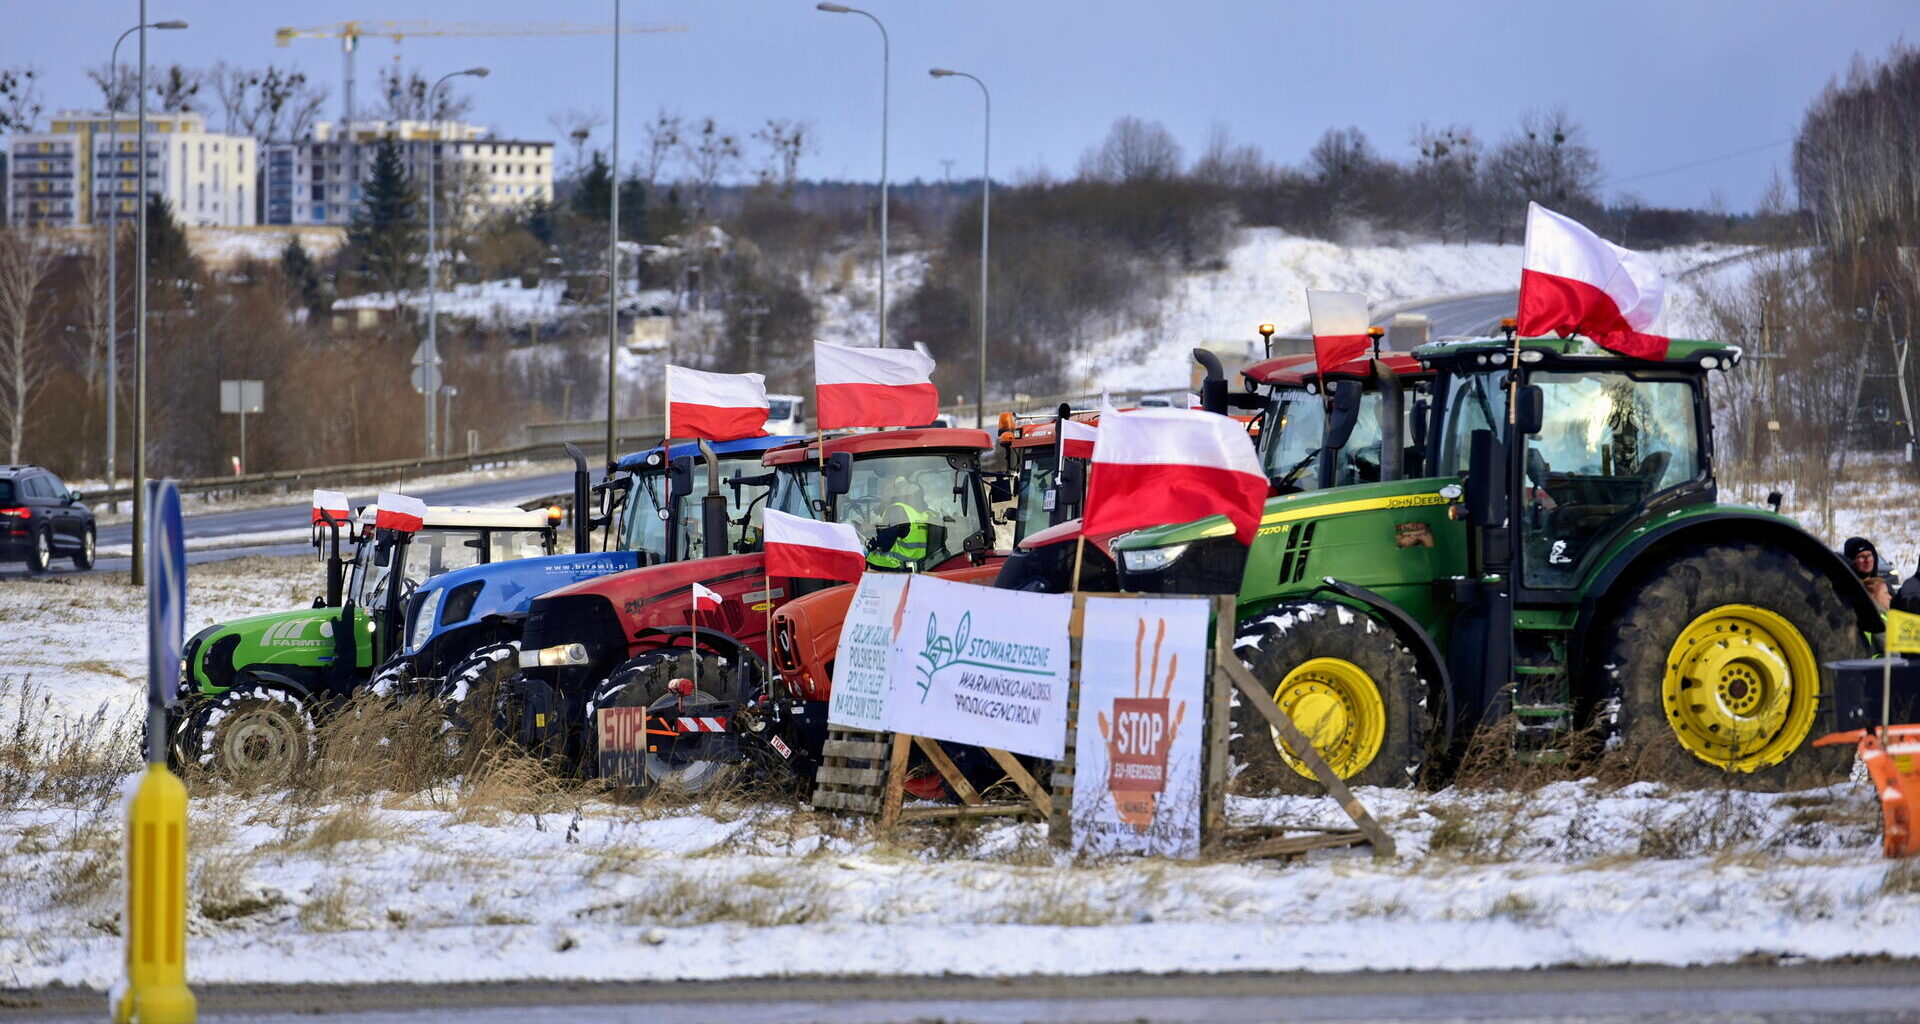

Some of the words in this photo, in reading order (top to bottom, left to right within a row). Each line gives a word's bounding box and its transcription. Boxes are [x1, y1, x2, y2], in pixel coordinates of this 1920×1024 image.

[1386, 498, 1412, 508] JOHN
[1414, 495, 1446, 505] DEERE
[1256, 525, 1281, 538] 7270
[1282, 524, 1289, 533] R
[544, 562, 629, 571] www.birawit.pl
[273, 639, 333, 647] FARMT
[968, 637, 1050, 667] STOWARZYSZENIE
[954, 693, 1016, 722] PRODUCENCI
[1016, 704, 1041, 725] ROLNI
[604, 706, 642, 751] STOP
[1117, 711, 1163, 756] STOP
[772, 736, 786, 752] TUR
[784, 749, 791, 757] 5
[1114, 762, 1163, 781] EU-MERCOSUR
